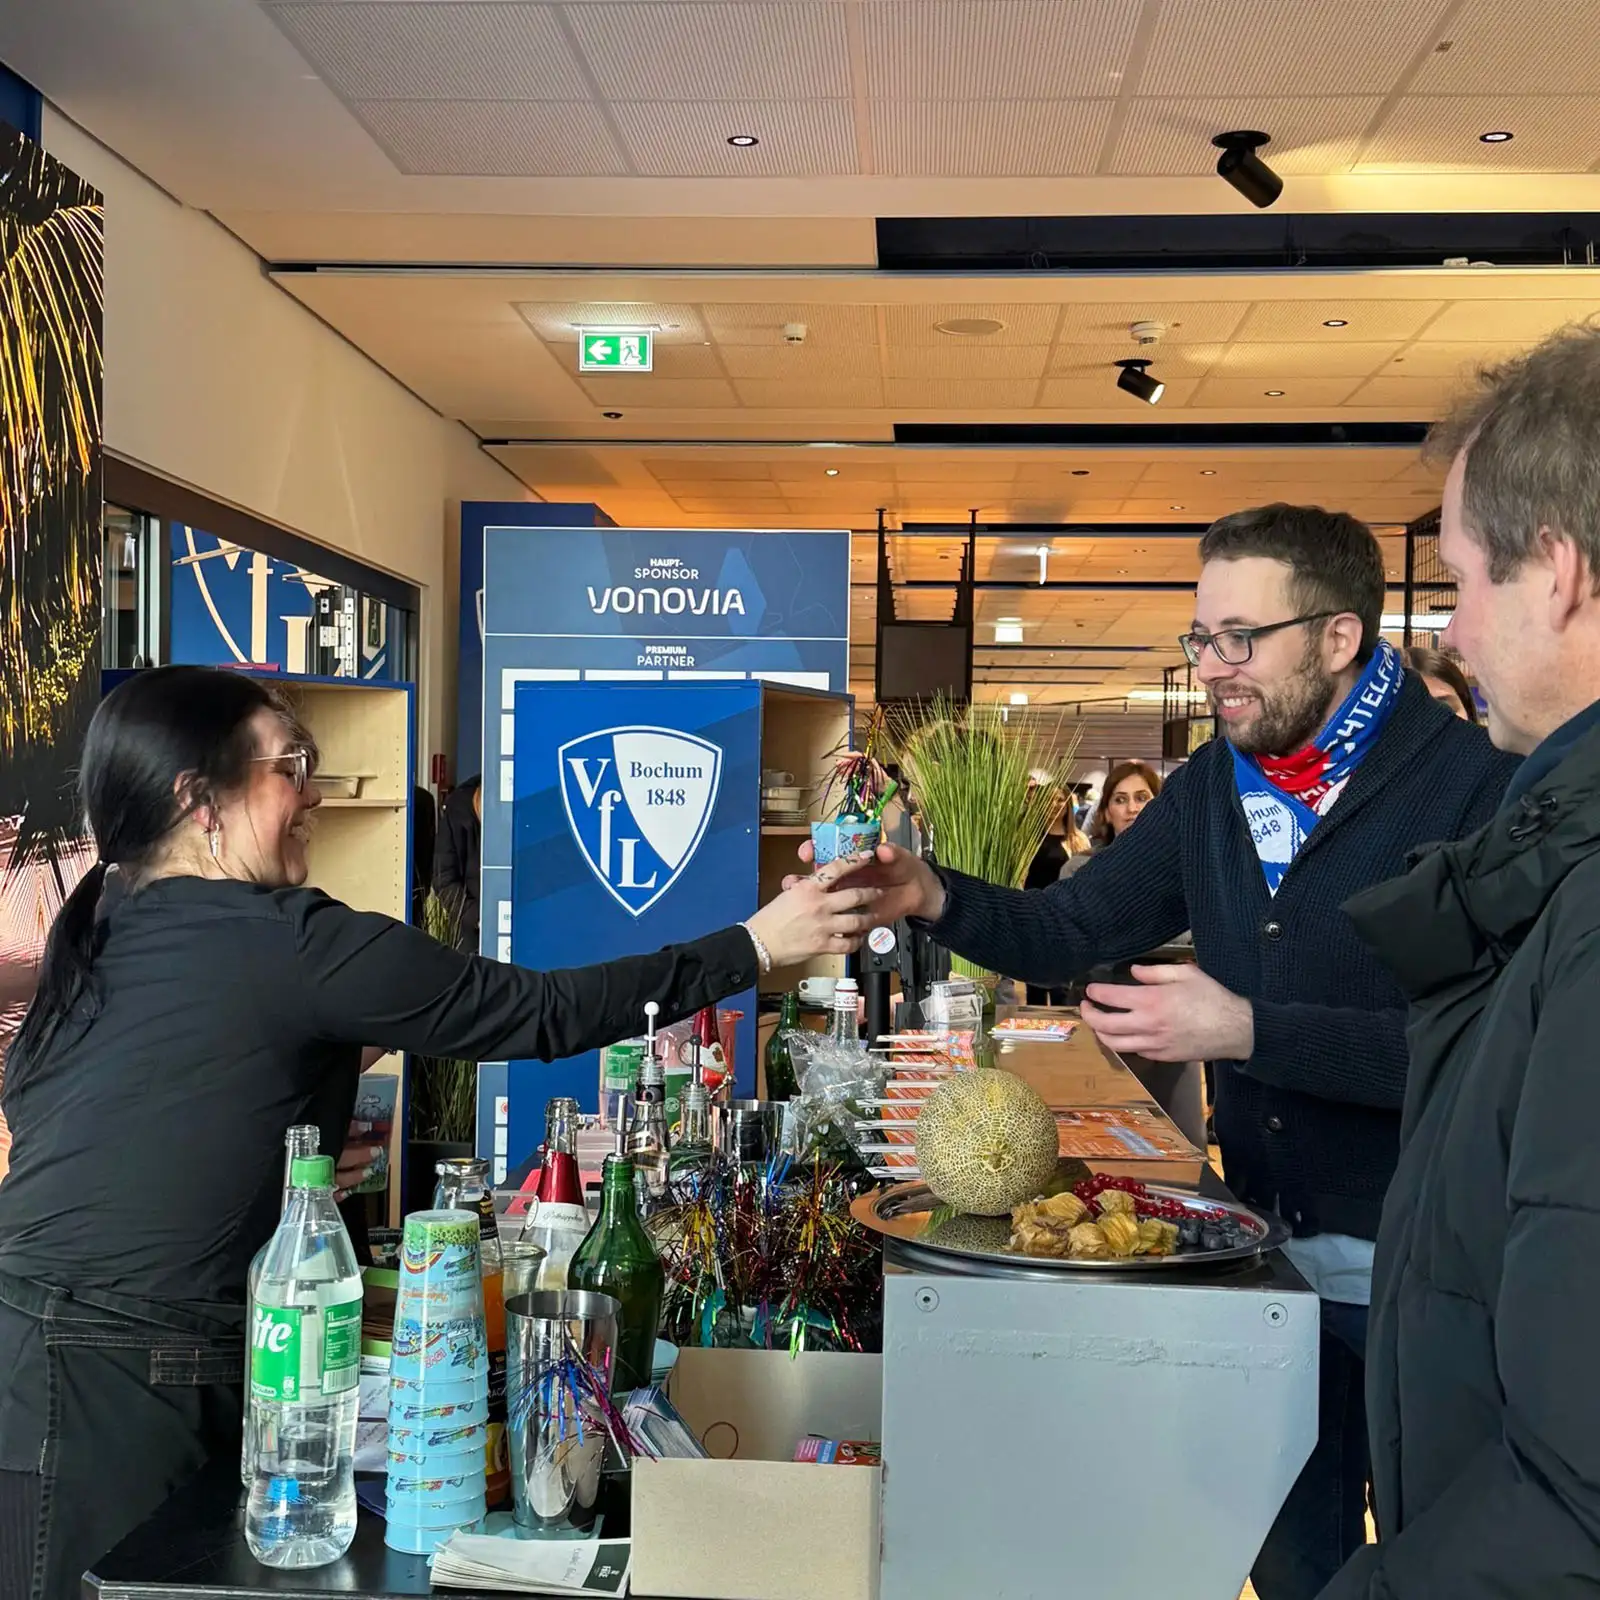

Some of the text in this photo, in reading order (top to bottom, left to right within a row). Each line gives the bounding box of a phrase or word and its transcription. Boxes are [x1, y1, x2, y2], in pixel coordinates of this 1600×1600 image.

[650, 558, 683, 567] HAUPT-
[634, 568, 699, 580] SPONSOR
[645, 645, 687, 654] PREMIUM
[637, 655, 695, 667] PARTNER
[629, 761, 703, 779] Bochum
[646, 788, 686, 806] 1848
[567, 758, 657, 889] VfL
[1252, 819, 1282, 844] 848
[253, 1307, 293, 1353] ite
